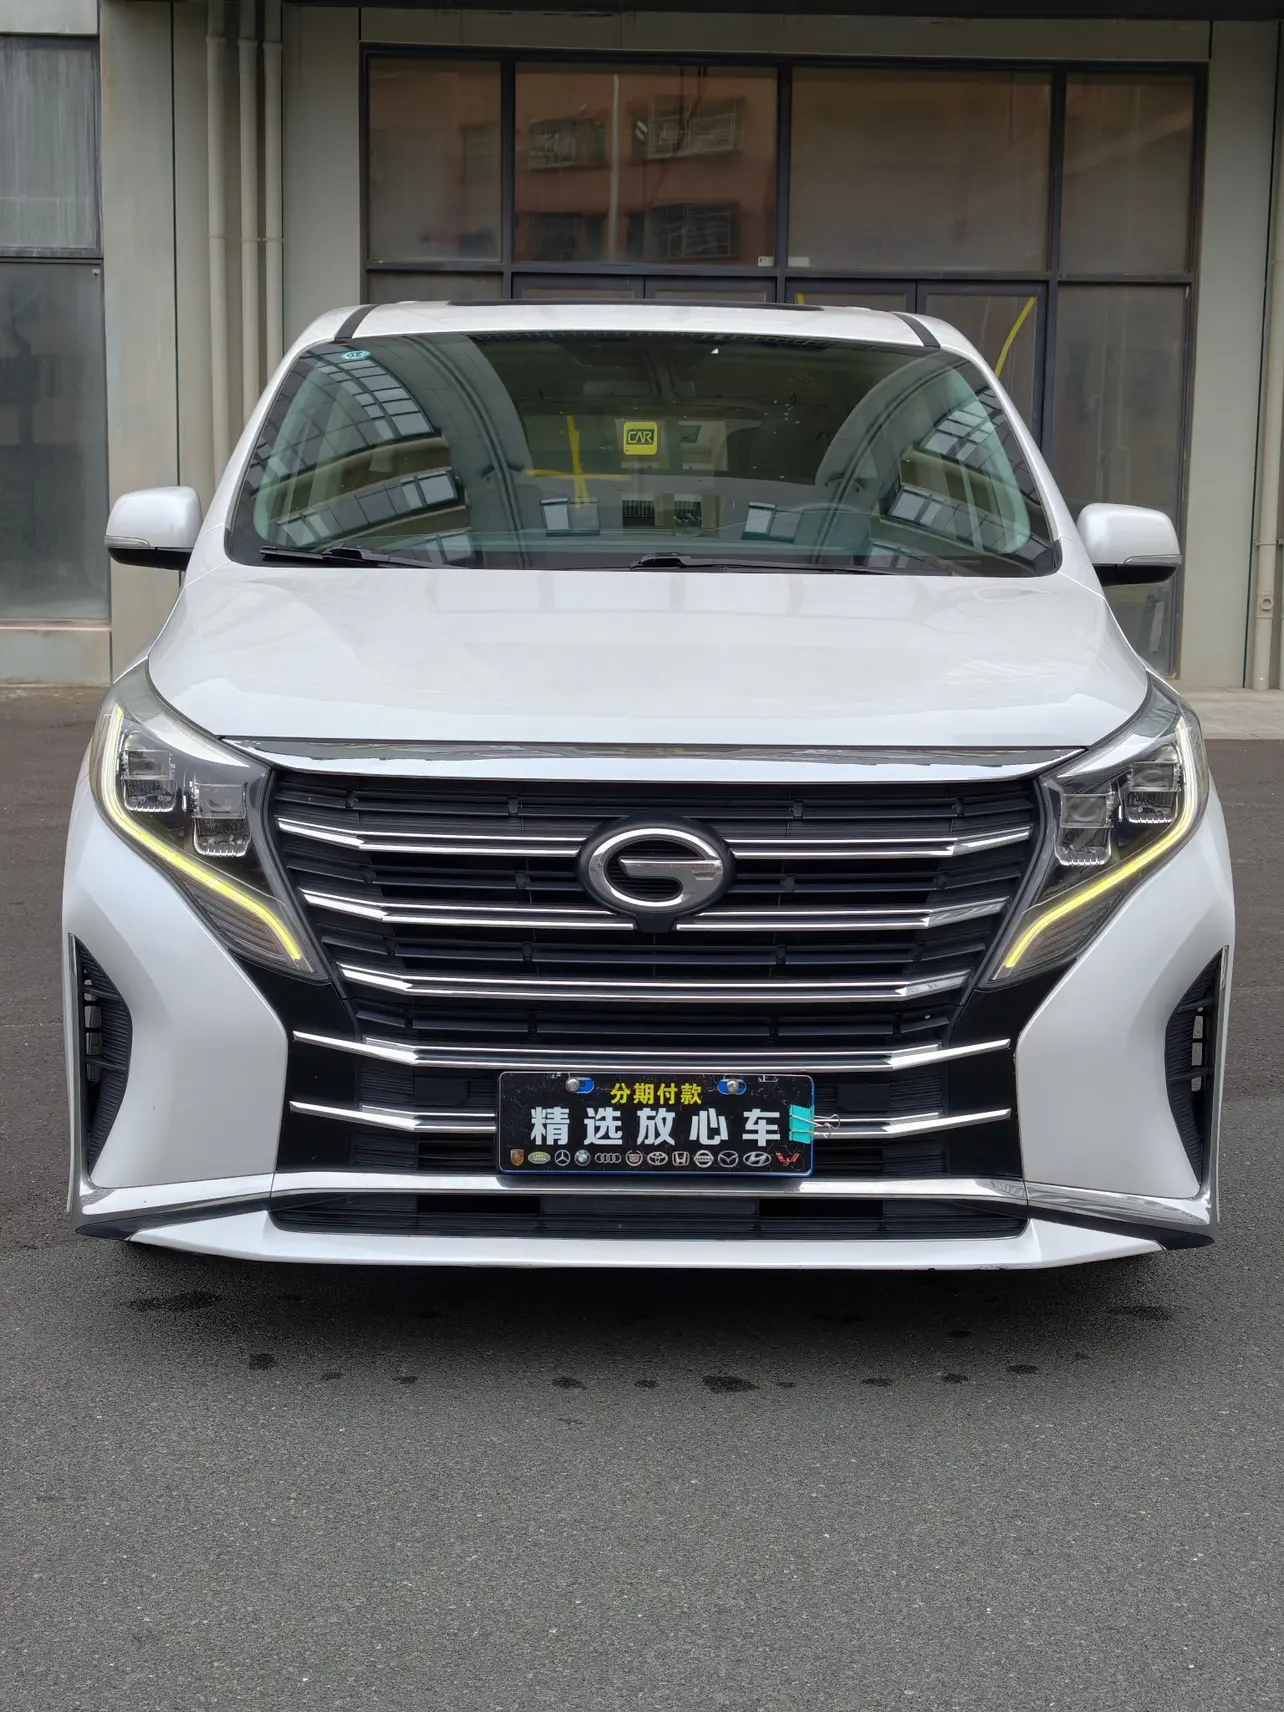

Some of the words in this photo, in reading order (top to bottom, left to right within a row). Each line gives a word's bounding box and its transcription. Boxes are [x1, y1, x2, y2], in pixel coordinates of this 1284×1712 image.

[628, 431, 653, 444] CAR
[610, 1083, 703, 1105] 分期付款
[530, 1107, 781, 1147] 精选放心车
